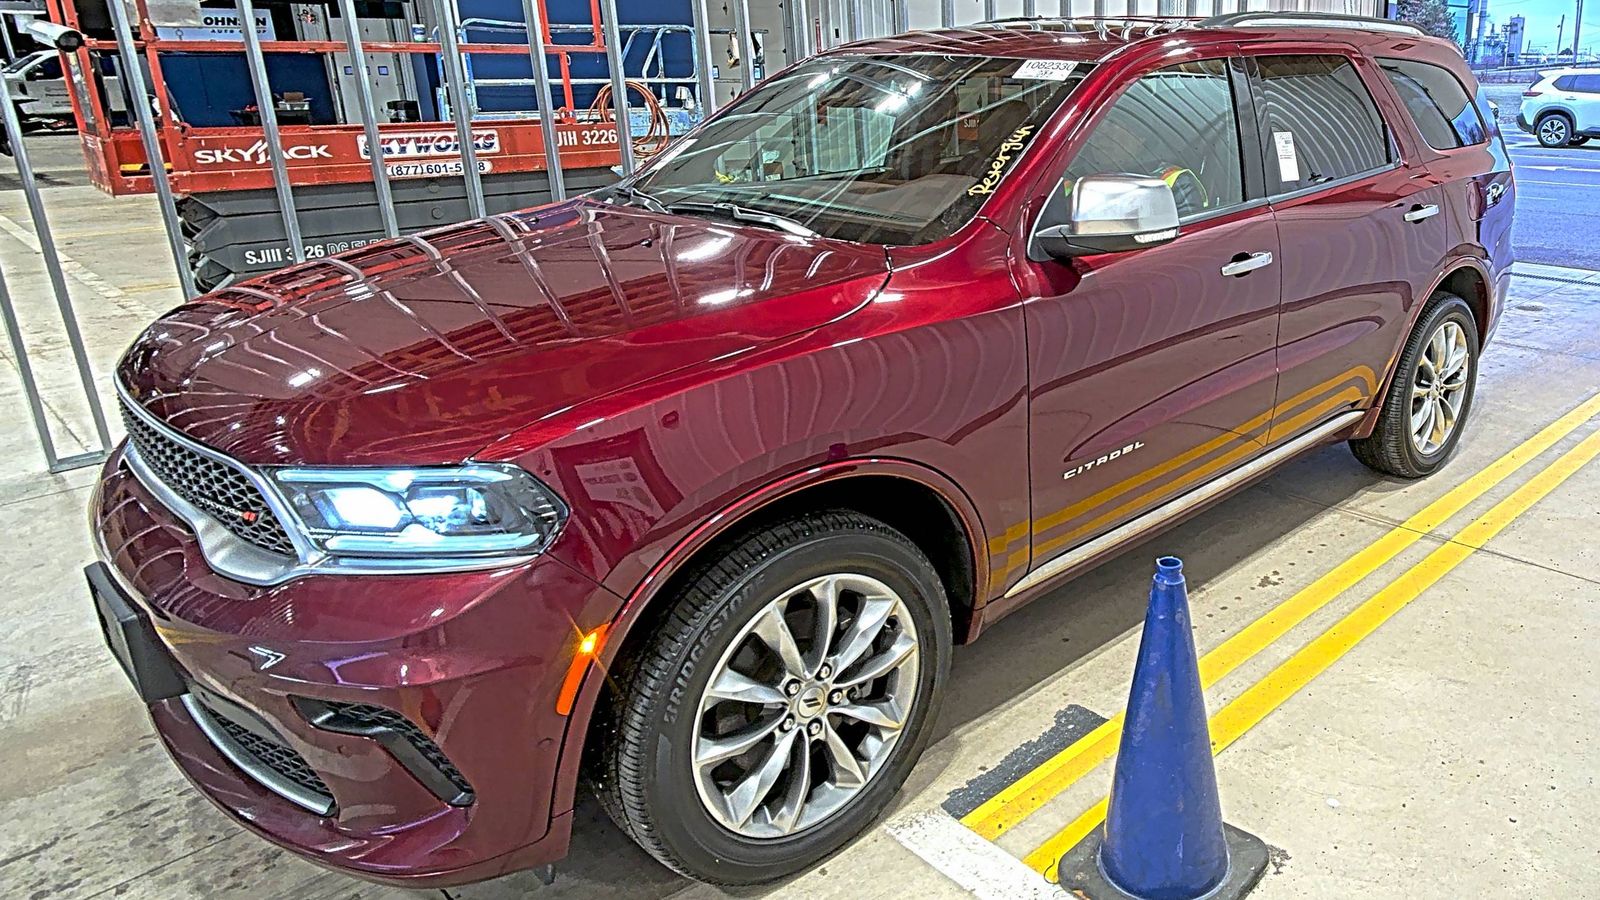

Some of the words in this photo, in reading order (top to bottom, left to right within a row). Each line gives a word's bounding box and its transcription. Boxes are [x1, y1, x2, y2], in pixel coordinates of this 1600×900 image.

[203, 16, 267, 26] OHNN
[1025, 61, 1076, 71] 1082330
[363, 133, 496, 156] KYWOKS
[581, 128, 618, 145] 3226
[426, 161, 486, 175] 601-58
[284, 244, 325, 261] 326
[1063, 441, 1145, 480] CITADEL
